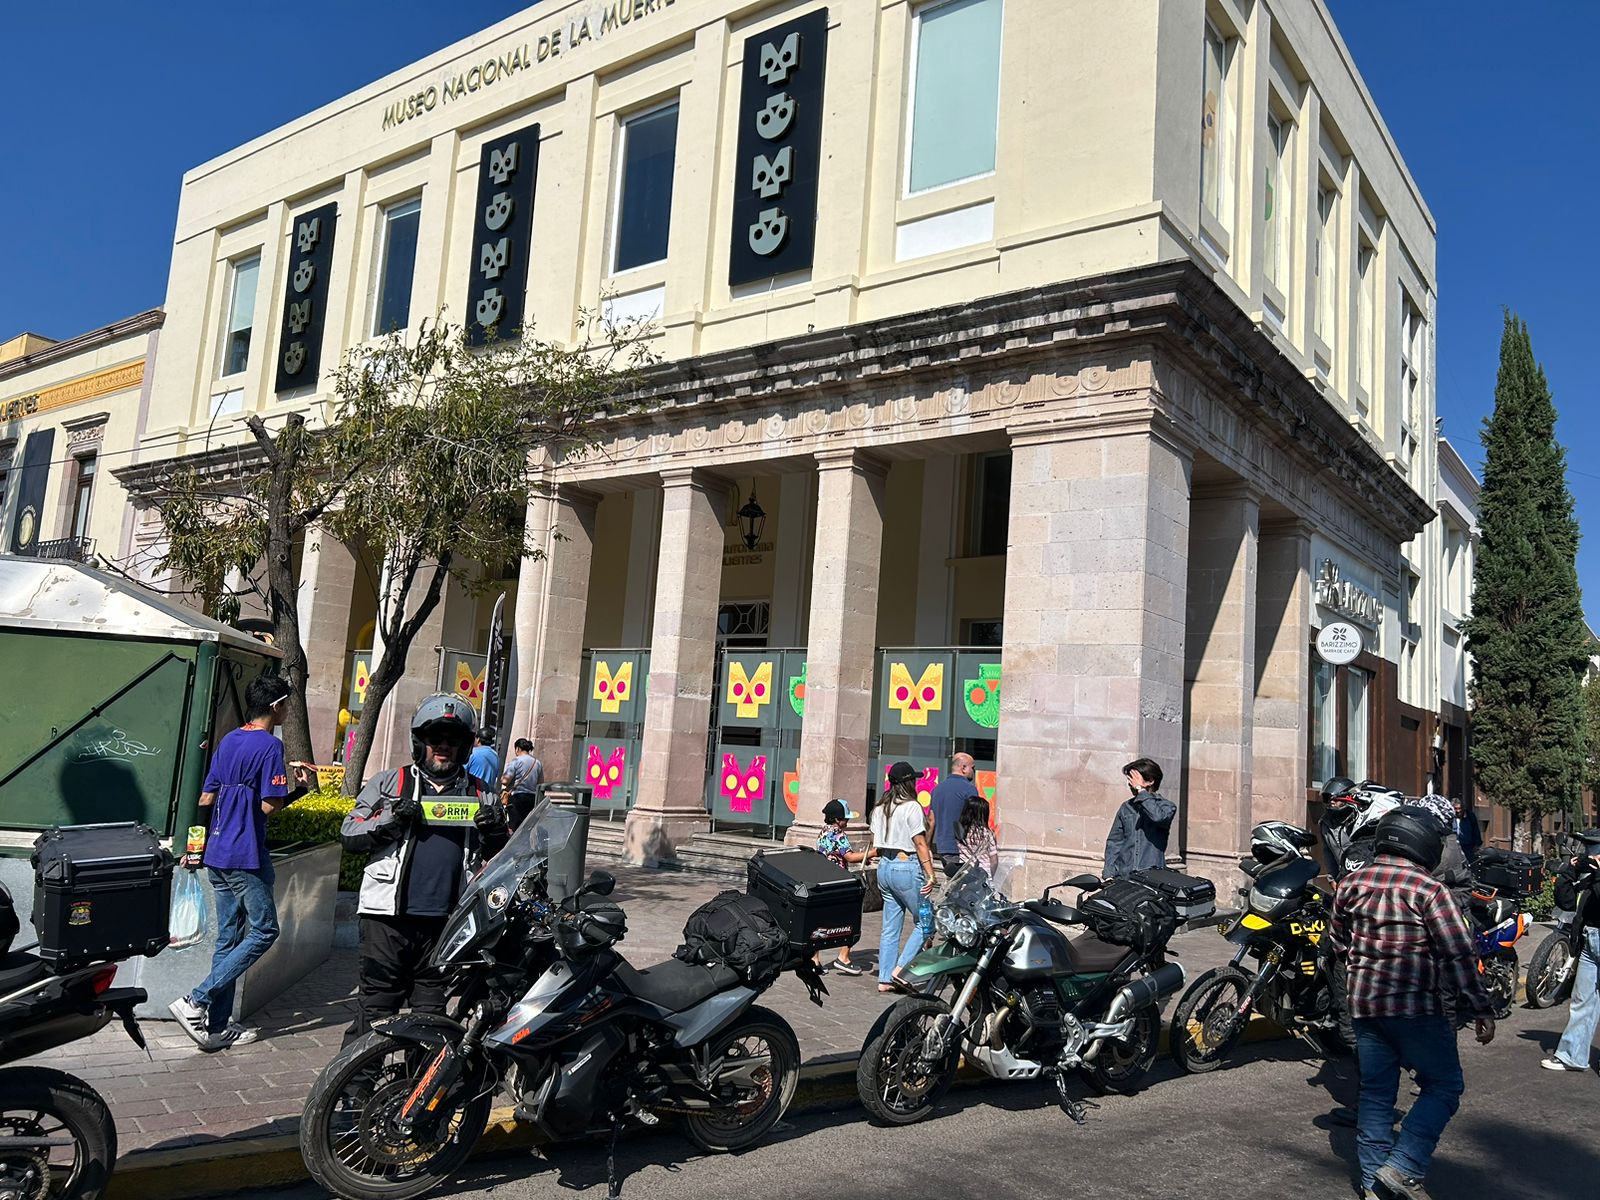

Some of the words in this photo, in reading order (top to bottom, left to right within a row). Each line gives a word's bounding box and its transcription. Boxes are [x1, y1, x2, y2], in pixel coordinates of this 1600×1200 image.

[382, 86, 437, 132] MUSEO
[442, 44, 531, 105] NACIONAL
[537, 29, 562, 63] DE
[569, 17, 591, 48] LA
[447, 807, 469, 816] RRM
